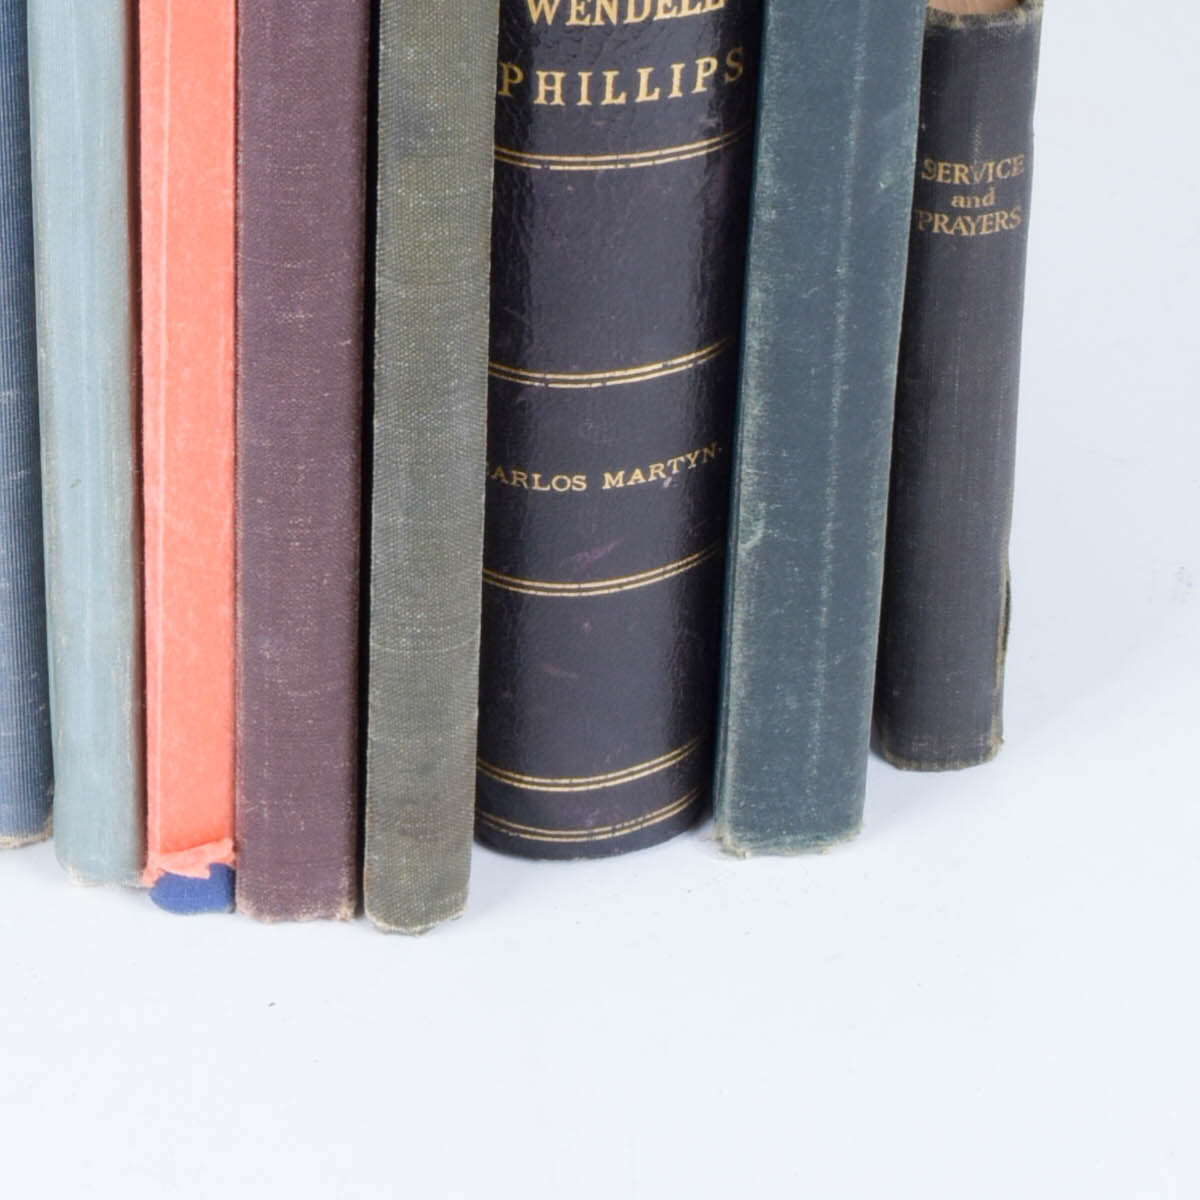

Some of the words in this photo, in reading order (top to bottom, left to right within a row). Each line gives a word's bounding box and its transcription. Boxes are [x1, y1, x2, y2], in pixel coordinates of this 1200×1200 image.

[498, 46, 744, 106] PHILLIPS
[921, 154, 1024, 185] SERVICE
[951, 186, 996, 209] and
[917, 205, 1022, 237] PRAYERS
[487, 462, 587, 492] ARLOS
